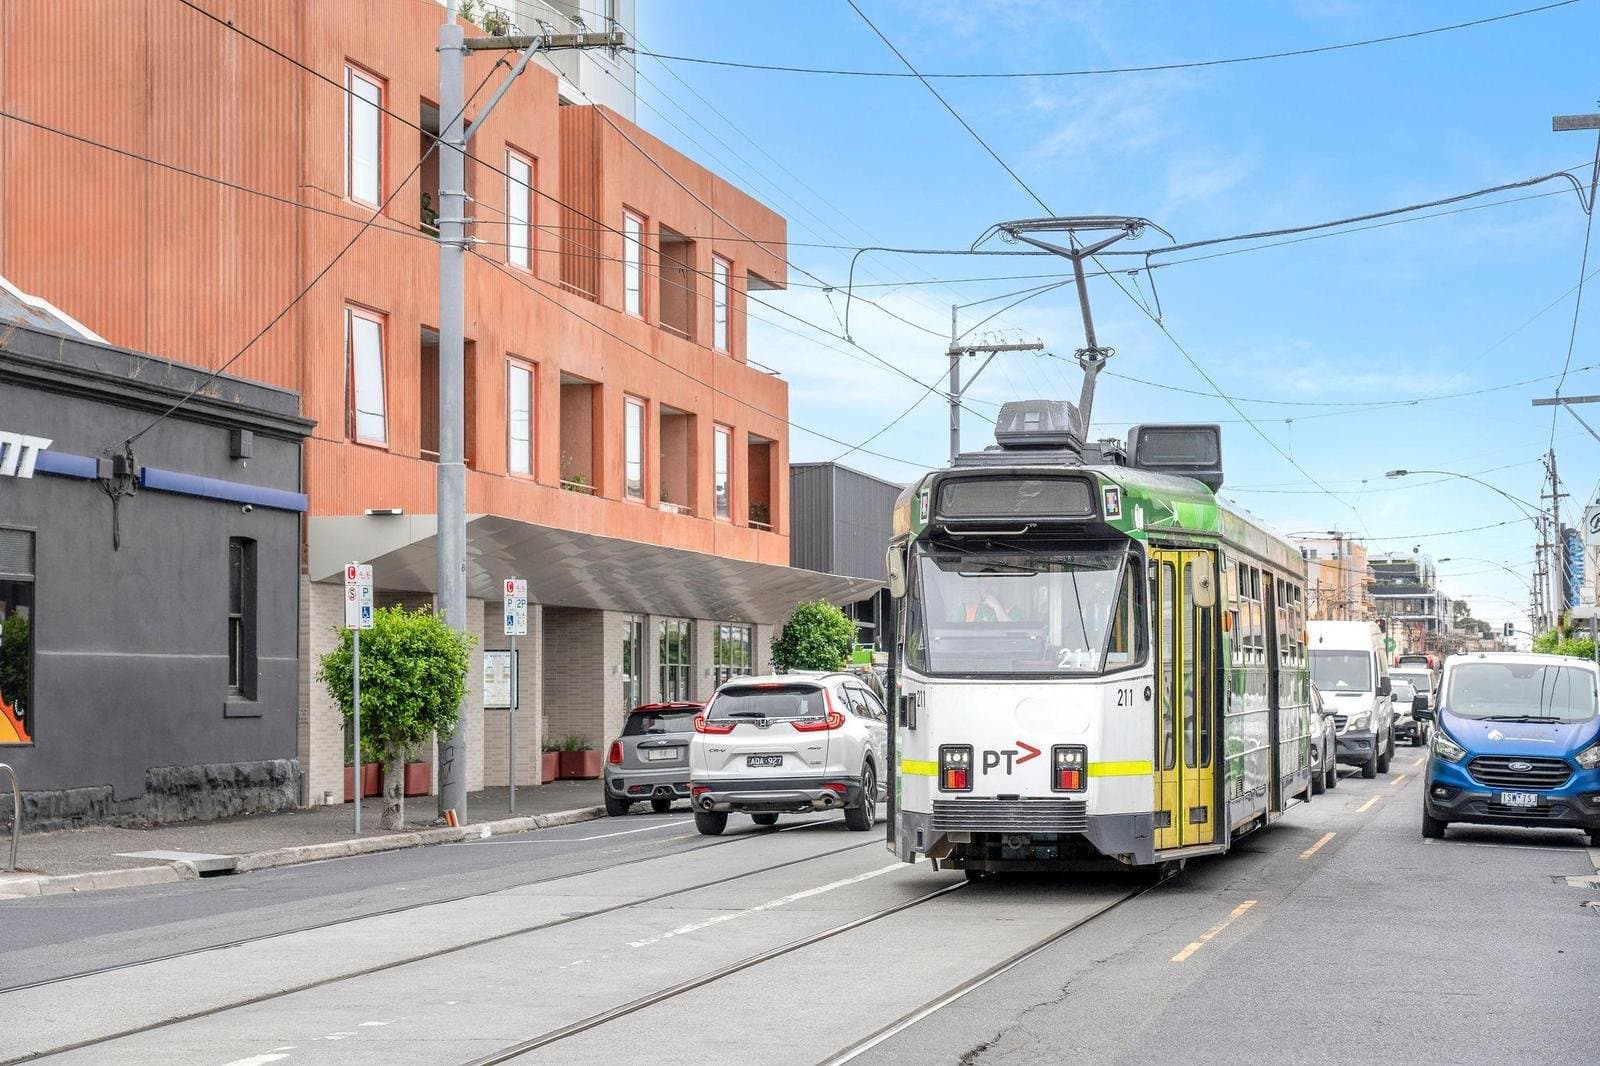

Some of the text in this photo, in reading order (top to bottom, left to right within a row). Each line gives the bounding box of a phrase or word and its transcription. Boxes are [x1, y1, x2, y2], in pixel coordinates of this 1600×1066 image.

[363, 588, 369, 597] P
[508, 599, 513, 608] P
[517, 599, 526, 608] 2P
[1058, 648, 1096, 668] 211
[1117, 689, 1133, 706] 211
